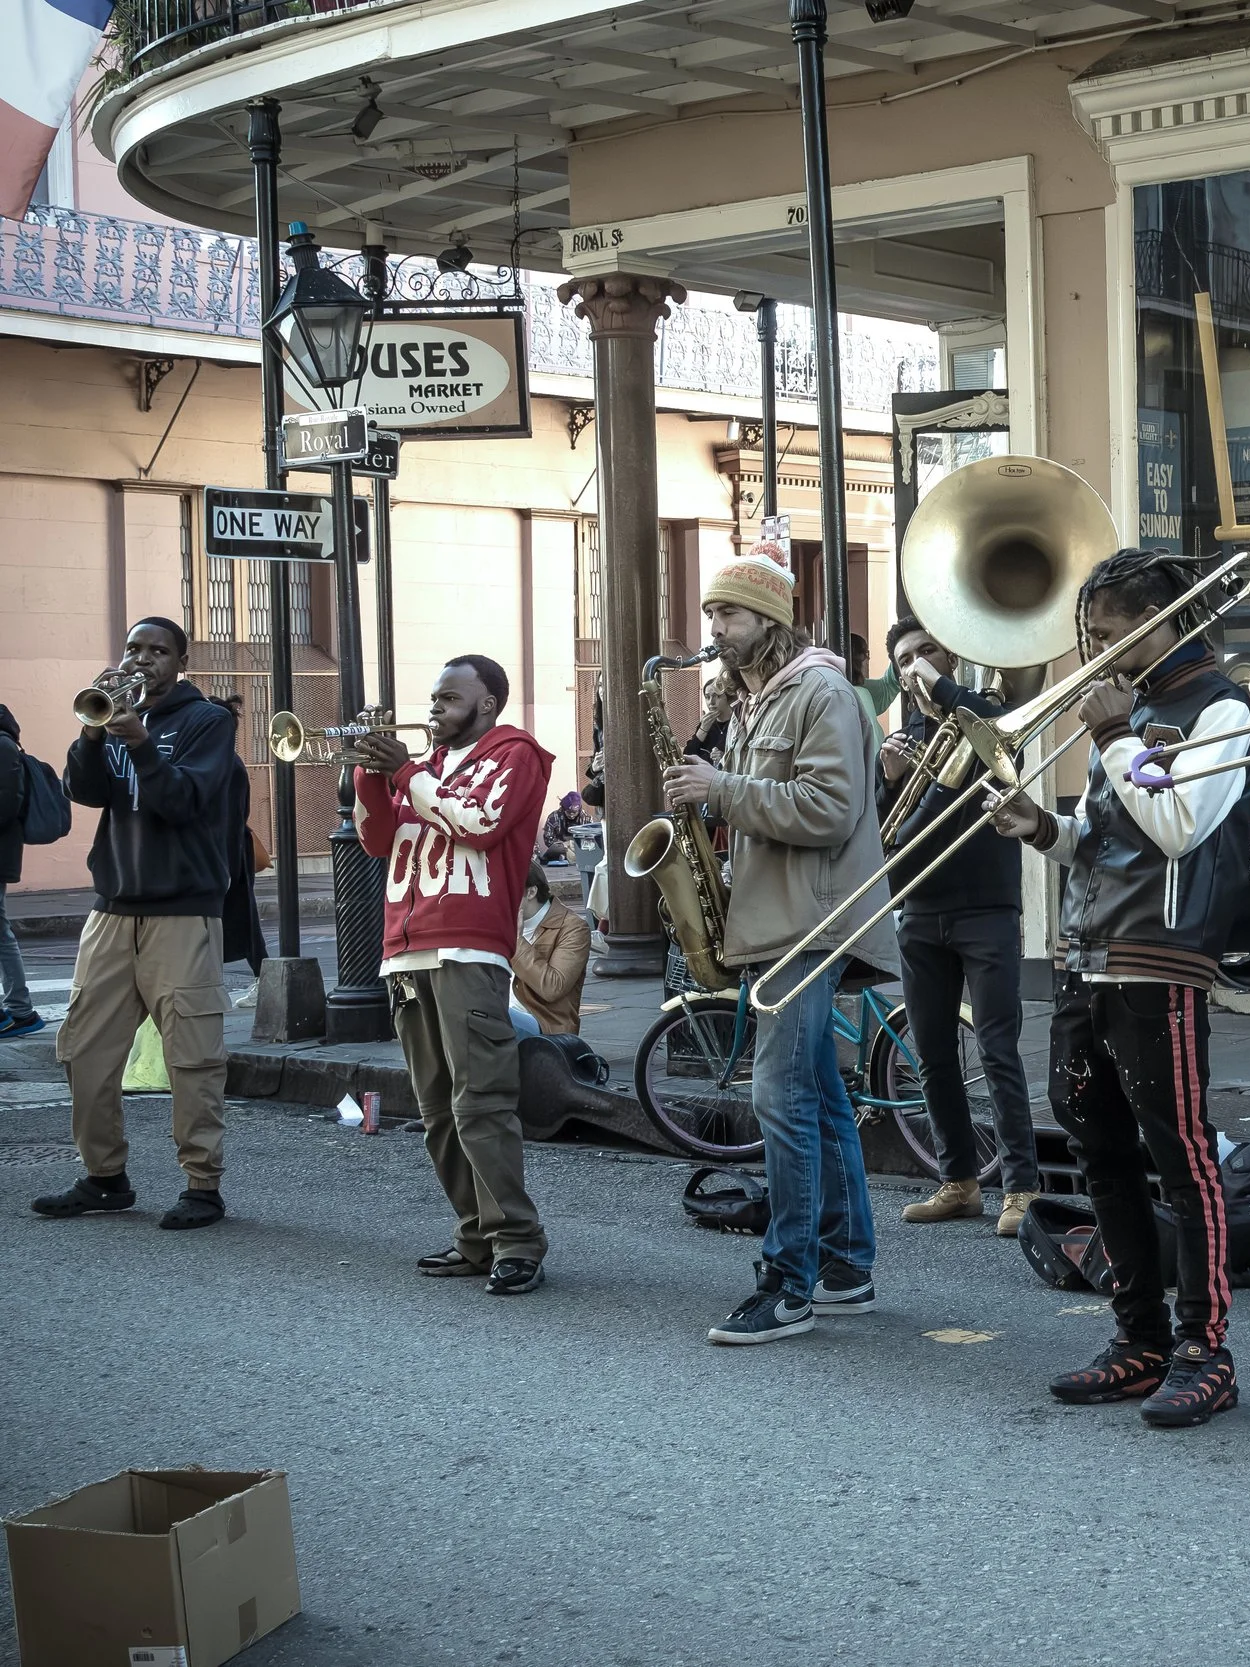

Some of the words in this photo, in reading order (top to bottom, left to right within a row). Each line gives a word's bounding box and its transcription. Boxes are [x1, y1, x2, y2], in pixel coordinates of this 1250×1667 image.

[352, 341, 470, 379] OUSES
[409, 382, 483, 399] MARKET
[365, 401, 406, 415] isiana
[411, 400, 466, 414] Owned
[300, 426, 350, 454] Royal
[1146, 462, 1174, 488] EASY
[1153, 488, 1168, 513] TO
[216, 511, 264, 537] ONE
[274, 513, 321, 540] WAY
[1140, 513, 1181, 539] SUNDAY
